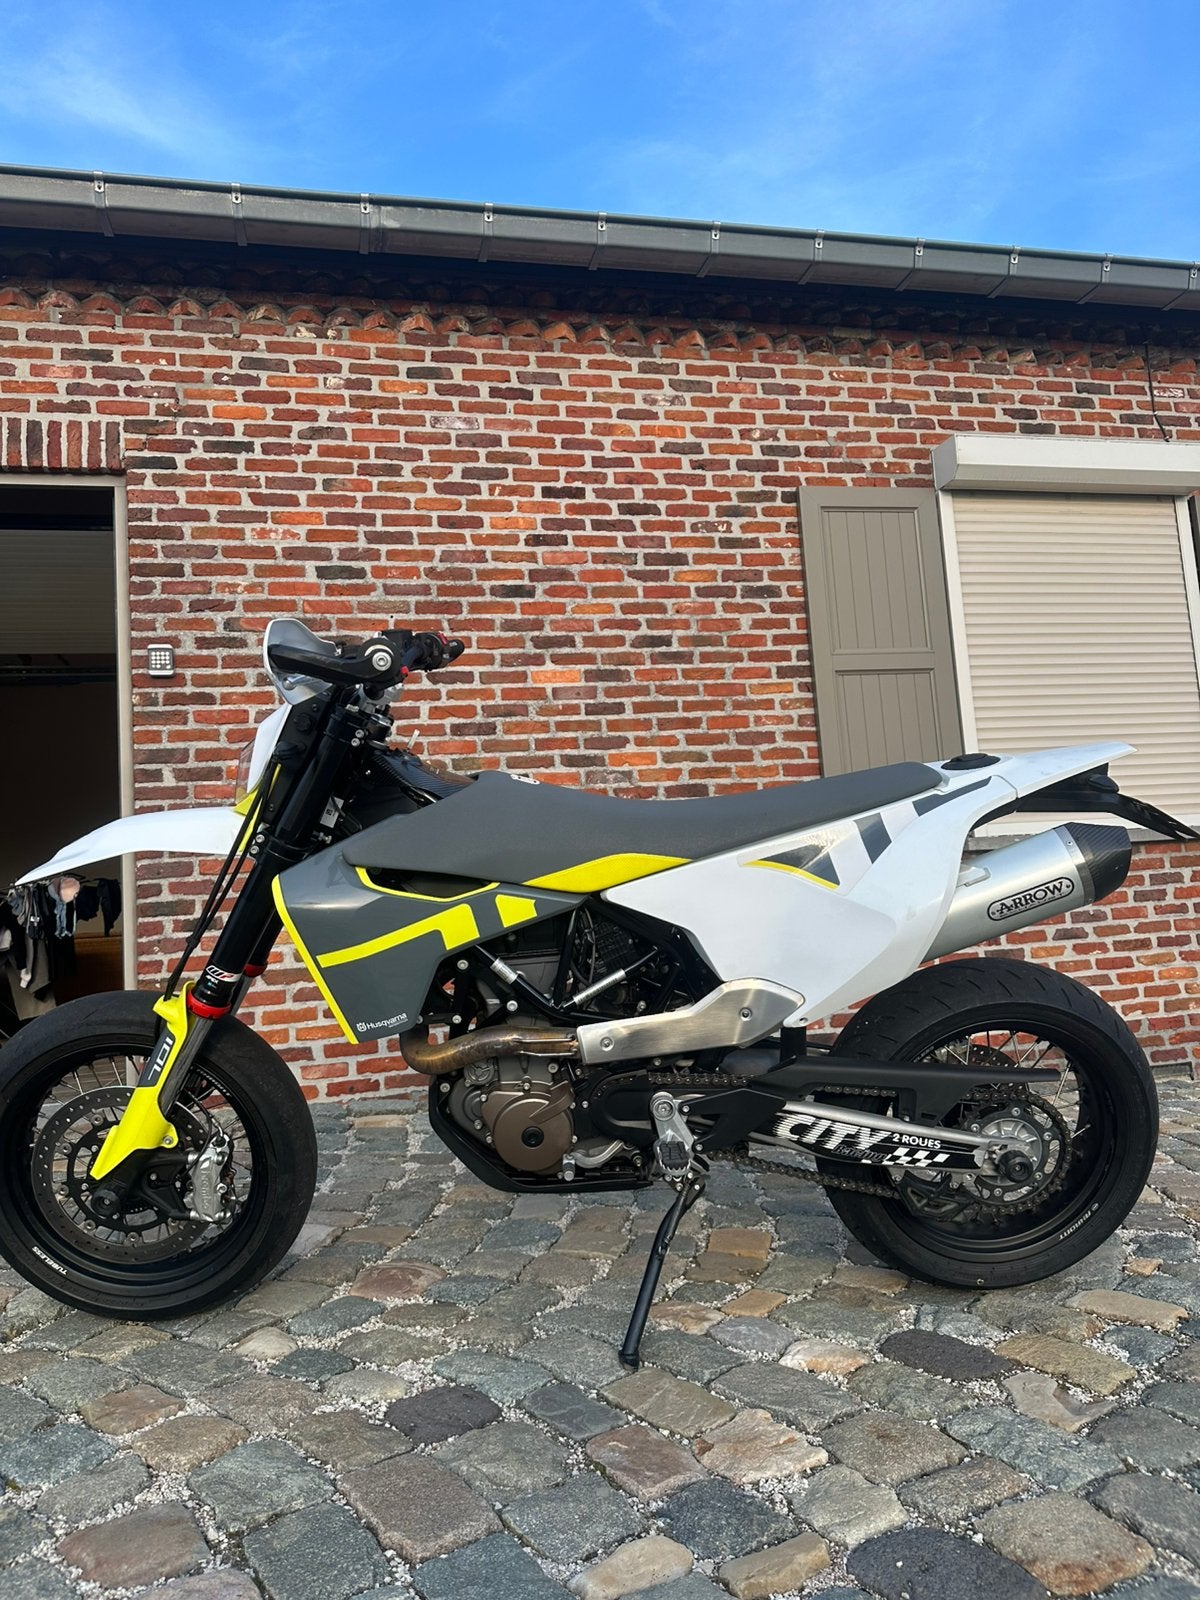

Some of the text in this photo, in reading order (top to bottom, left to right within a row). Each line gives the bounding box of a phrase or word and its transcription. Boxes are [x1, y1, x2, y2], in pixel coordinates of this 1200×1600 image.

[996, 880, 1063, 914] ARROW
[366, 1013, 407, 1029] Husqvarna
[148, 1036, 174, 1080] 701
[773, 1112, 942, 1150] CITY 2 ROUES
[32, 1246, 67, 1276] TUBELESS
